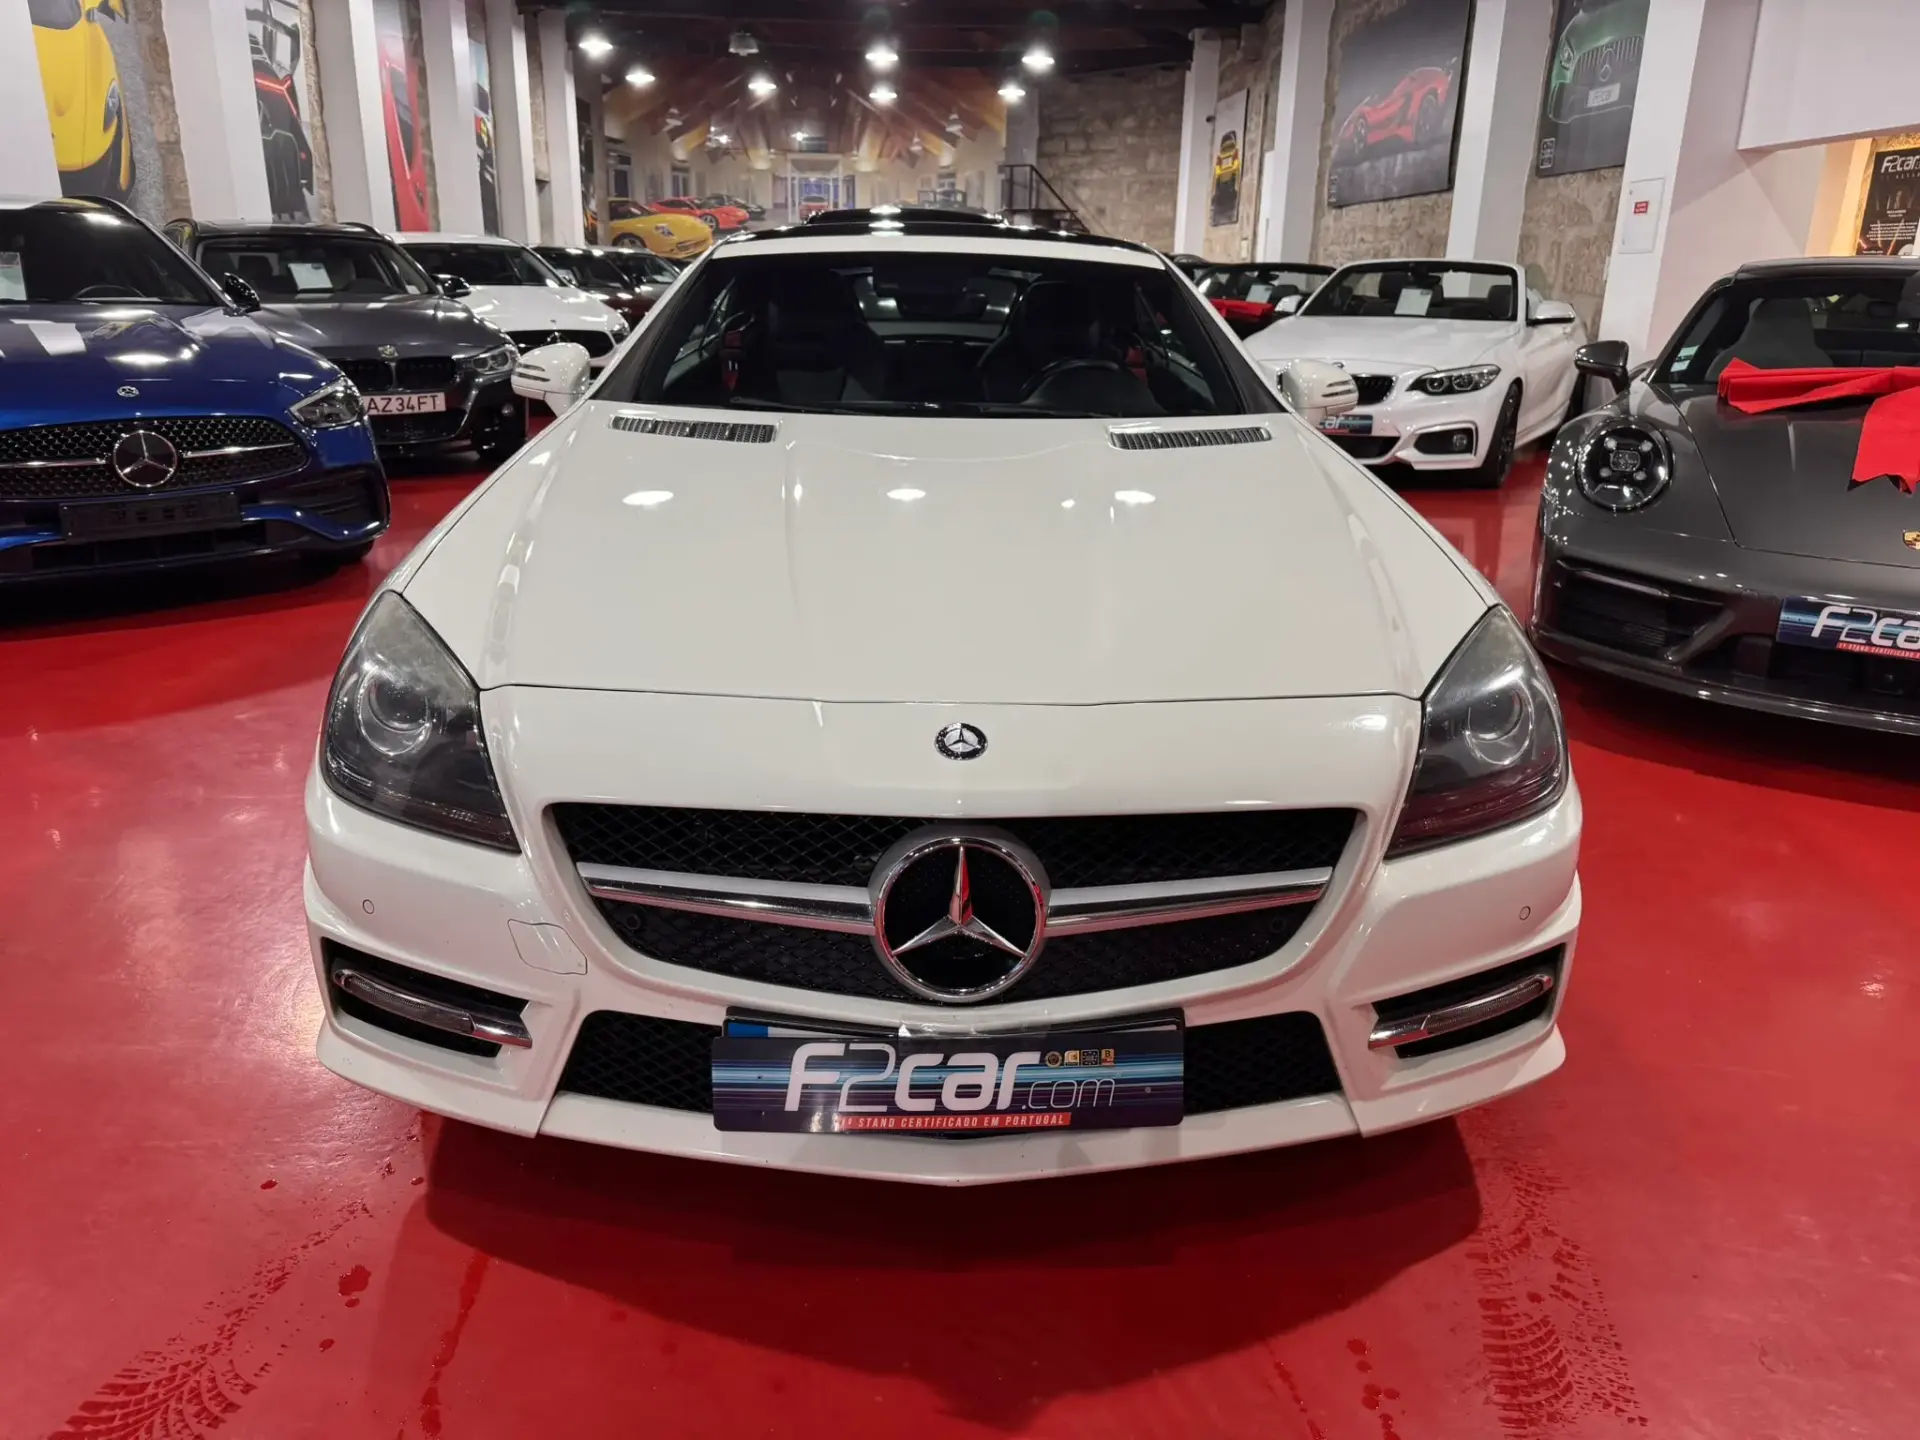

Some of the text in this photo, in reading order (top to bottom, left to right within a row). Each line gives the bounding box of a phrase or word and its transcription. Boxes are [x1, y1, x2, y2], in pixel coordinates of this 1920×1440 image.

[858, 1118, 895, 1128] STAND
[900, 1116, 978, 1128] CERTIFICADO
[983, 1116, 999, 1127] EM
[1005, 1114, 1065, 1126] PORTUGAL
